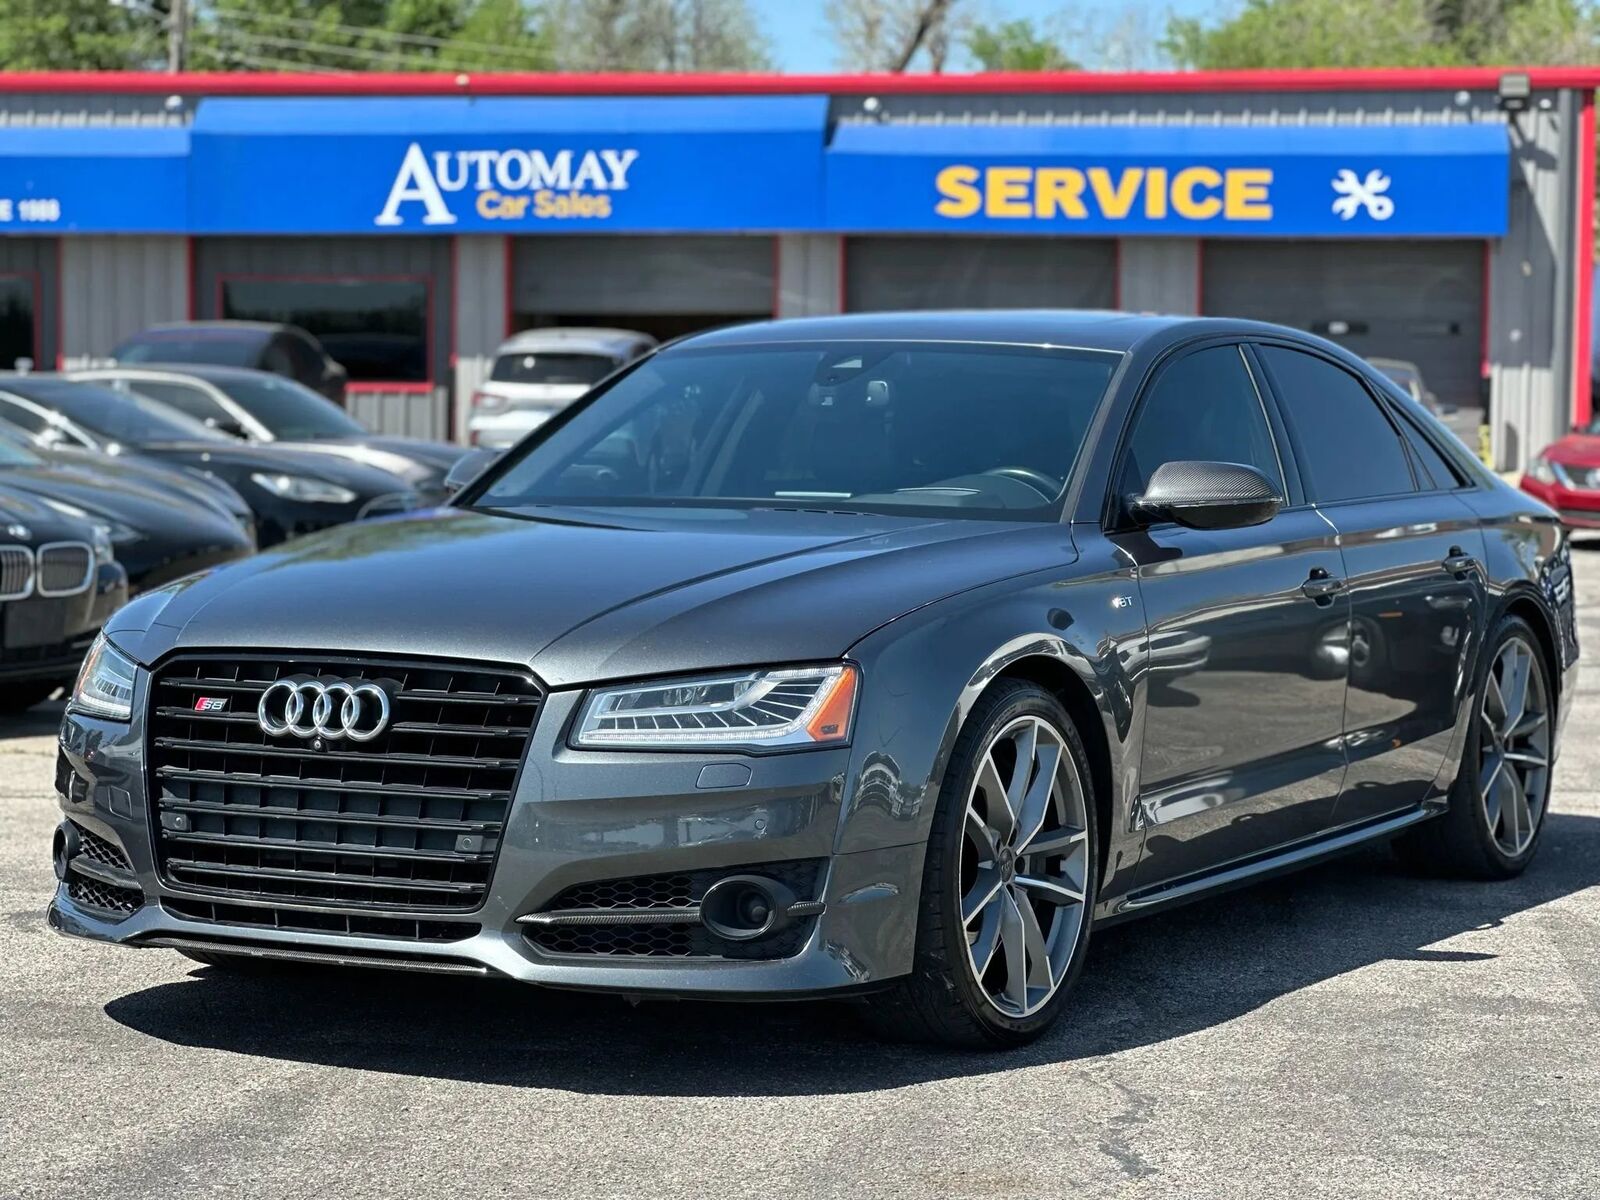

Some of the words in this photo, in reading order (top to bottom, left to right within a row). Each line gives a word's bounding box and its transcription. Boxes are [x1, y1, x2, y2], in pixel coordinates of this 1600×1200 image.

[375, 142, 638, 225] AUTOMAY
[476, 190, 529, 218] Car
[534, 190, 611, 218] Sales
[935, 165, 1273, 220] SERVICE
[200, 699, 225, 710] S8
